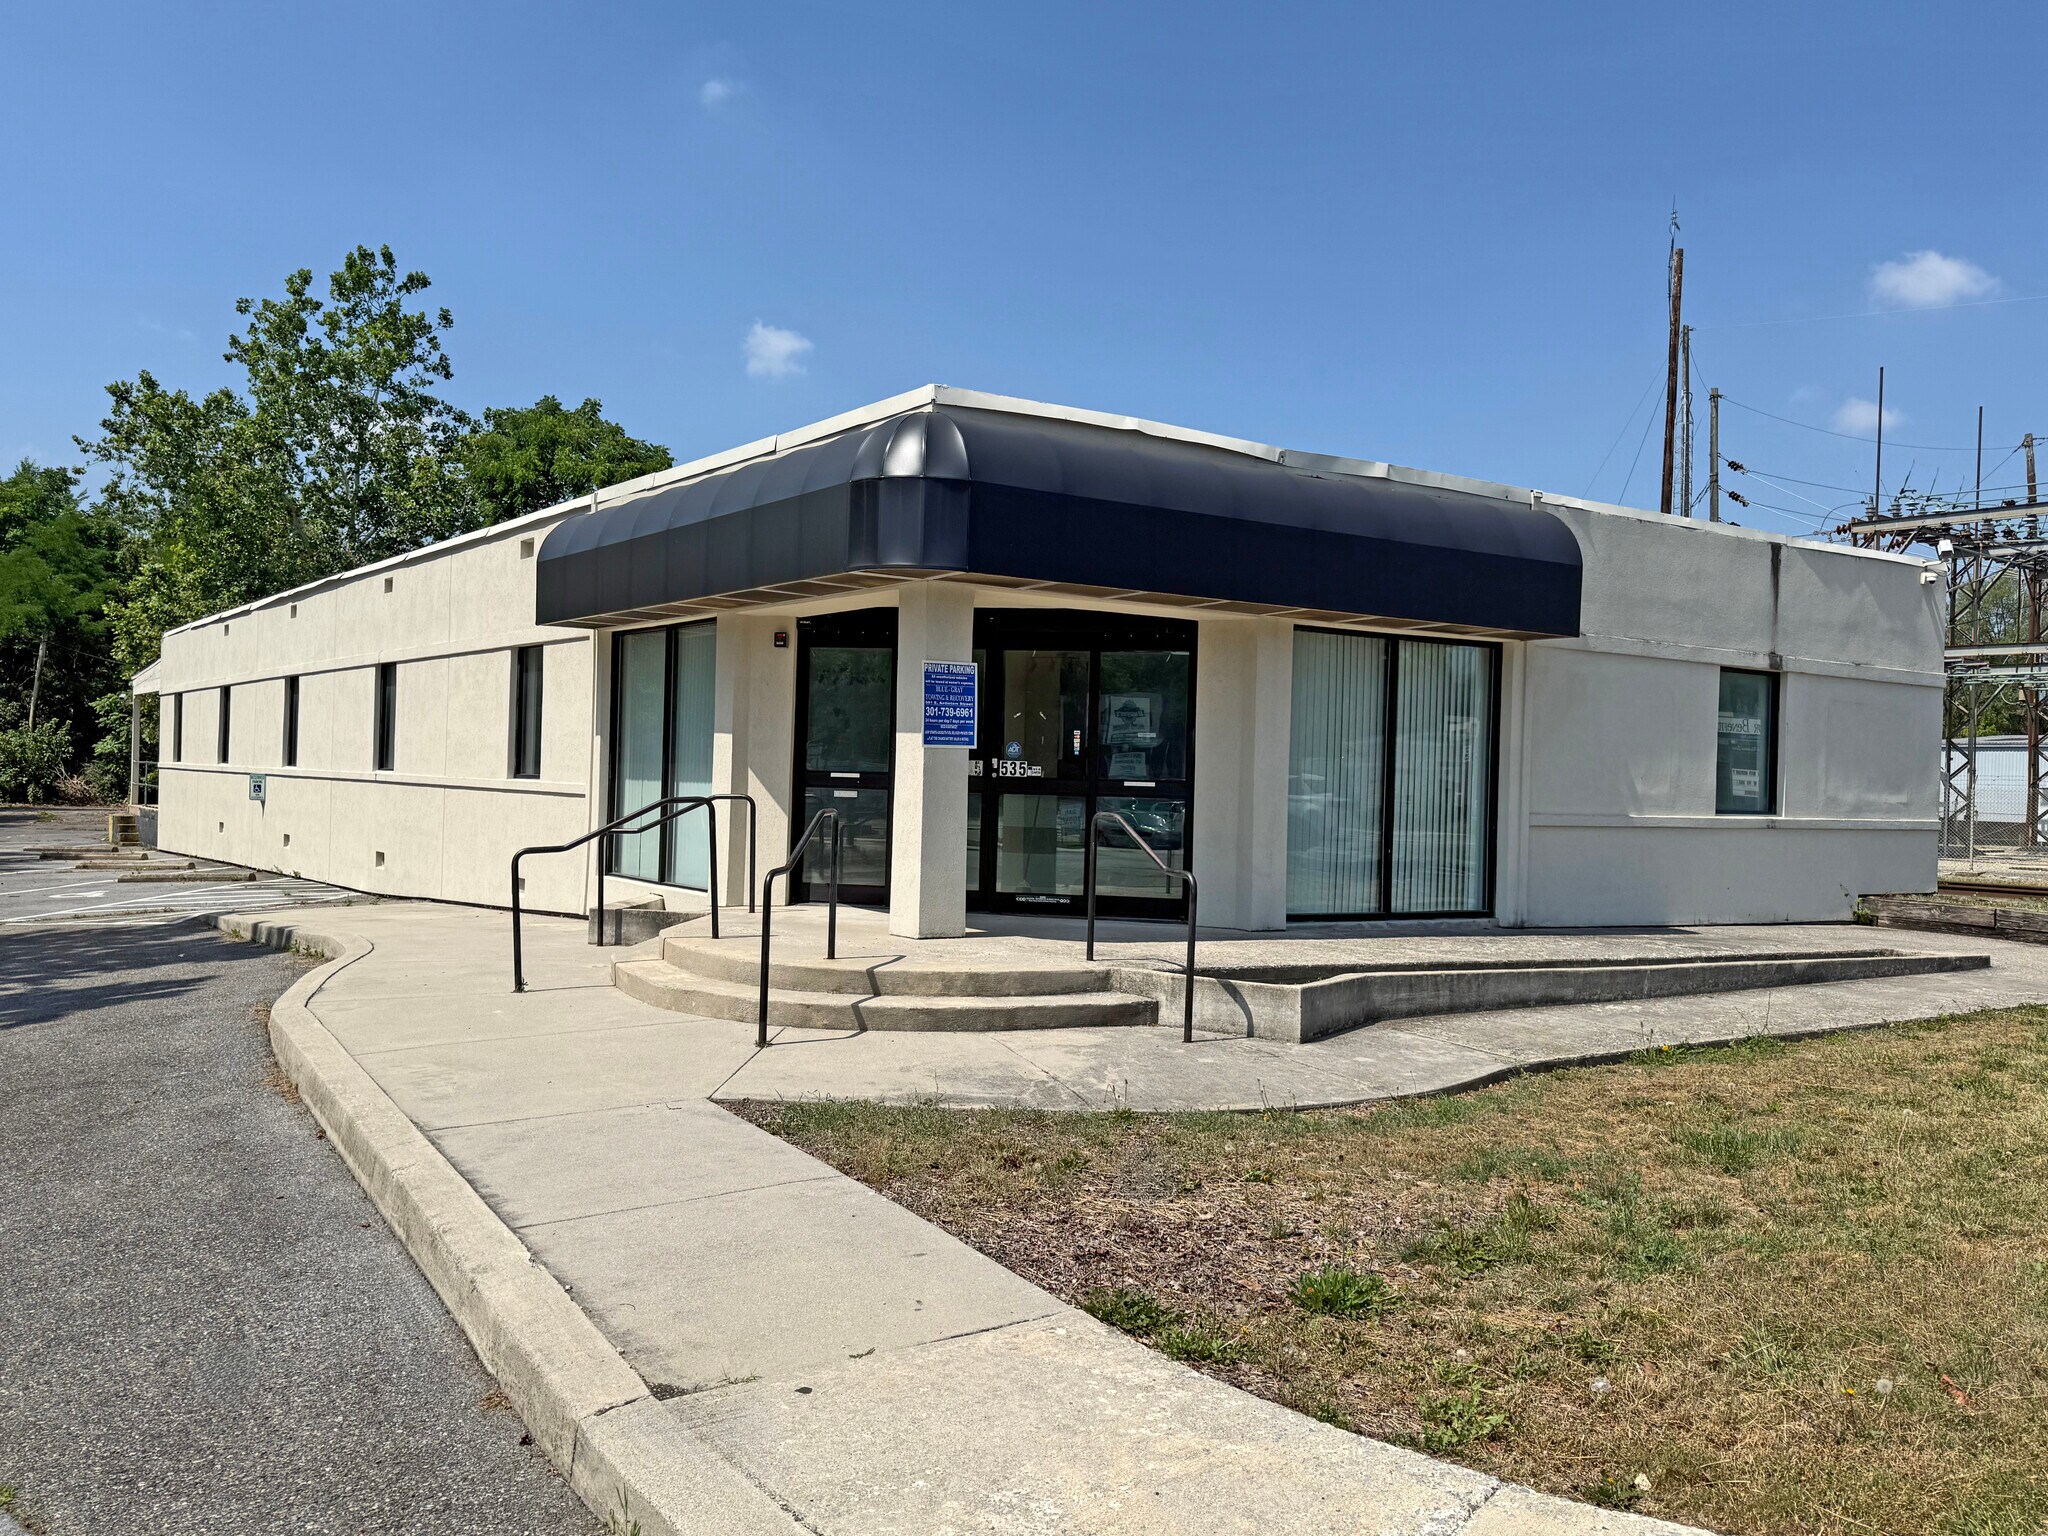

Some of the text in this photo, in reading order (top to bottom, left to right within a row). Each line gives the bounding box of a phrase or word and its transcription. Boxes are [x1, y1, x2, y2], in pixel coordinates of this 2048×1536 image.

[924, 663, 975, 674] PRIVATE PARKING
[926, 707, 973, 717] 301-739-6961
[1001, 761, 1026, 776] 535
